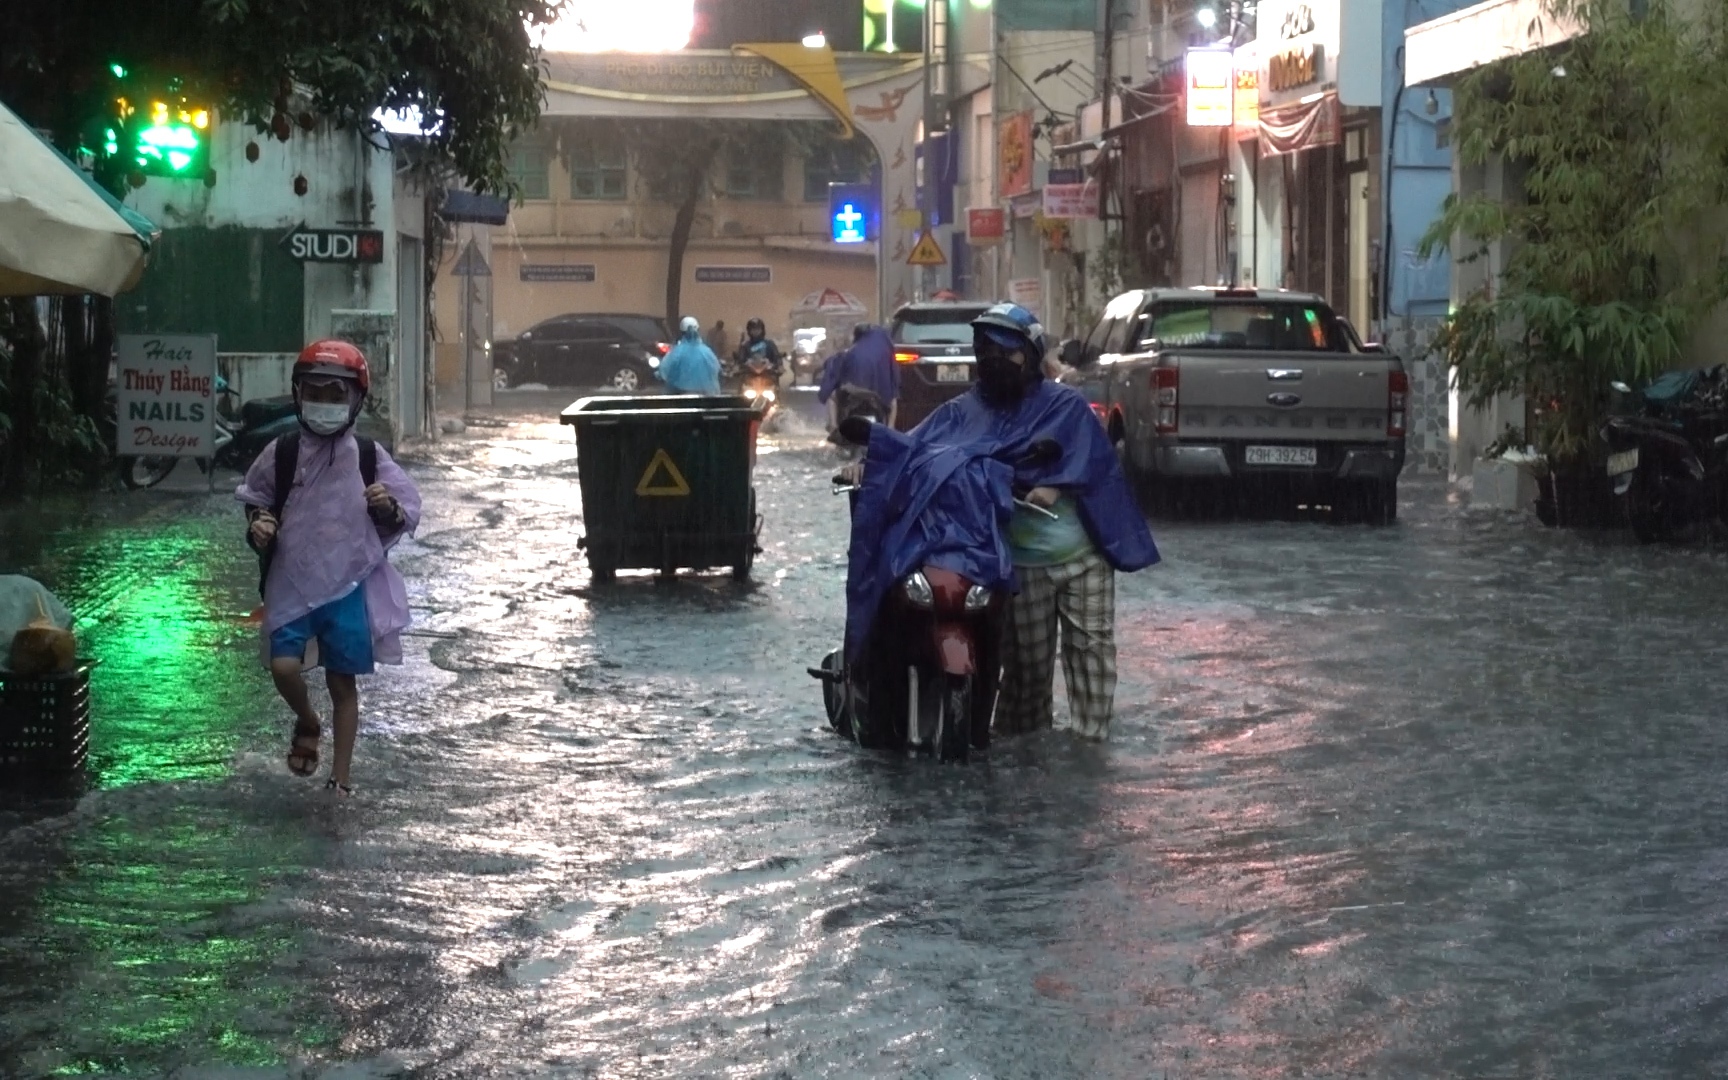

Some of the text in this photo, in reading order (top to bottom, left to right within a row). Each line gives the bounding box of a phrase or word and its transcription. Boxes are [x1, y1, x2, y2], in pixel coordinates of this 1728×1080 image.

[143, 340, 192, 360] Hair
[129, 401, 205, 422] NAILS
[133, 426, 200, 453] Design
